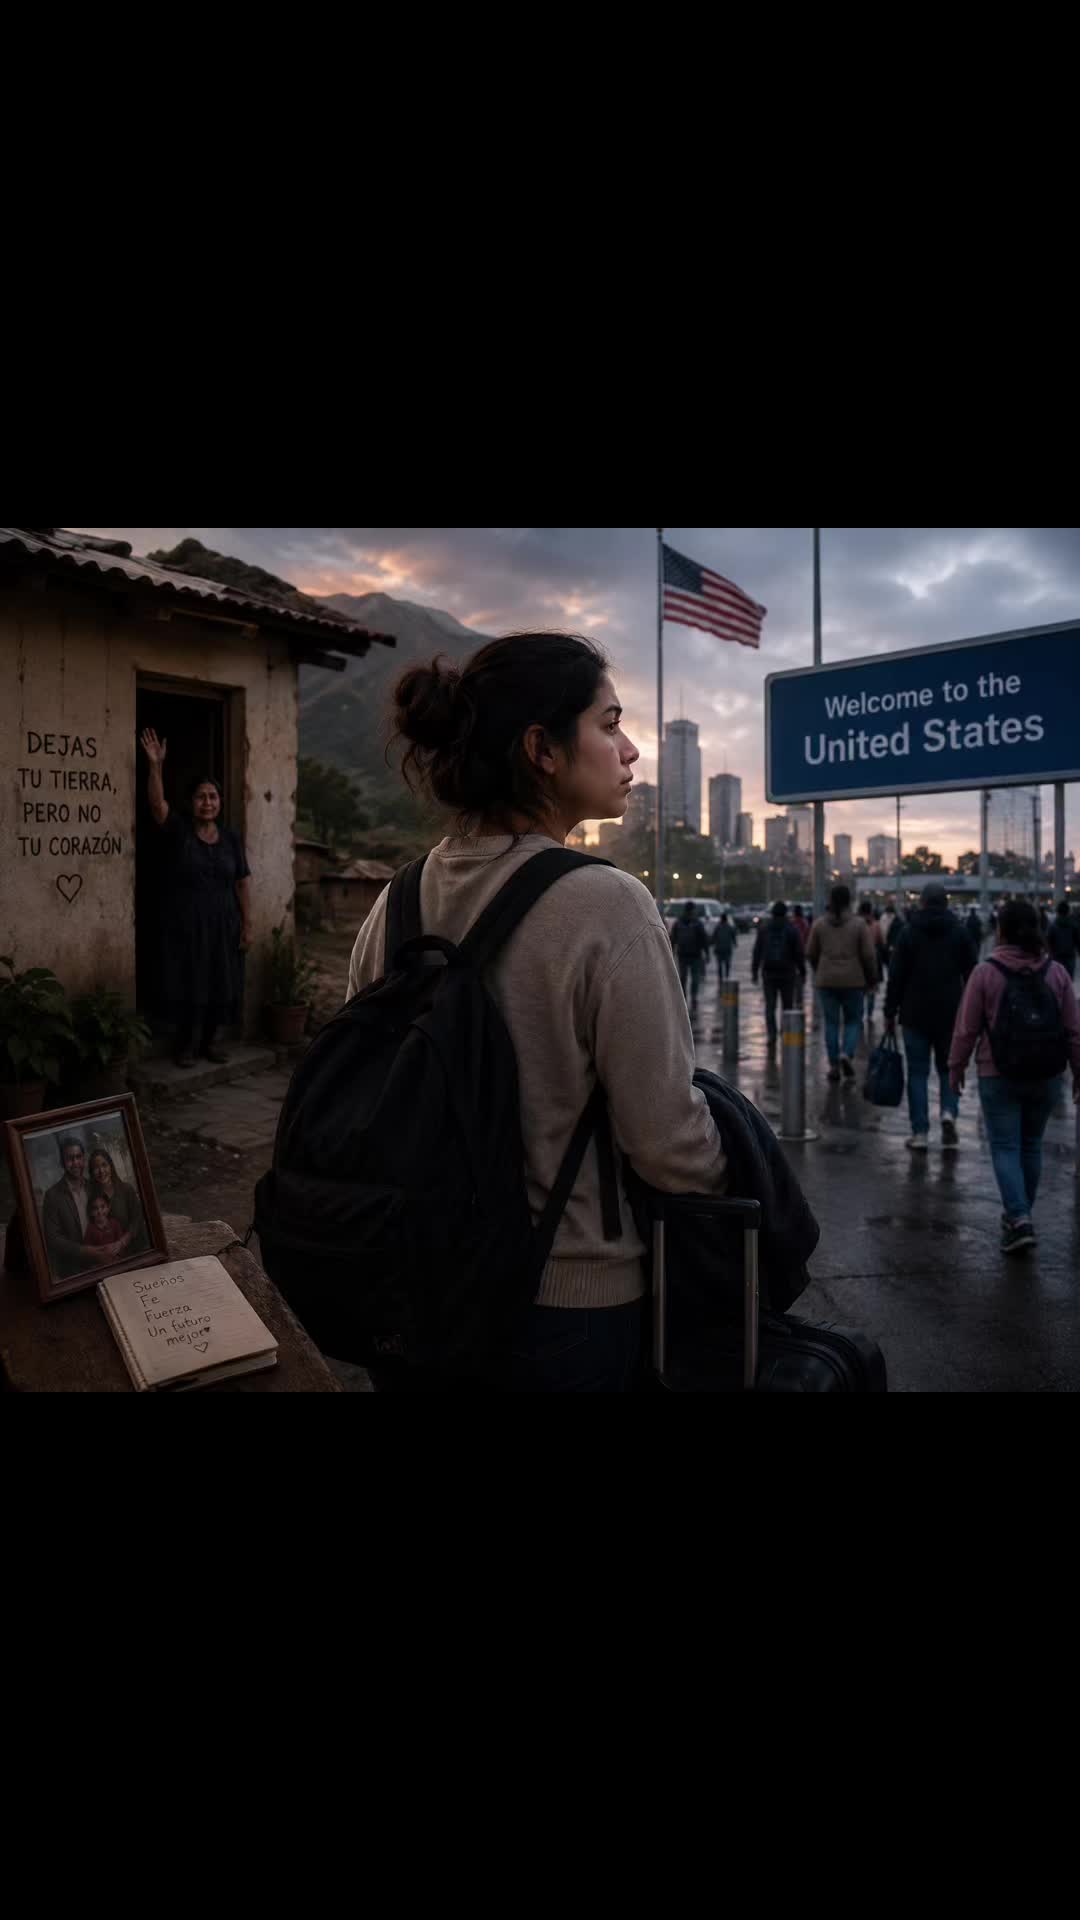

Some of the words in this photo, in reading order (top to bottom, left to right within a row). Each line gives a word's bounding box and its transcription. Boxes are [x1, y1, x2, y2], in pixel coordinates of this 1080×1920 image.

[824, 688, 934, 720] Welcome
[942, 681, 968, 702] to
[976, 672, 1022, 698] the
[27, 731, 97, 758] DEJAS
[804, 722, 911, 766] United
[922, 713, 1045, 753] States
[17, 768, 42, 789] TU
[49, 770, 117, 795] TIERRA,
[23, 802, 70, 824] PERO
[78, 804, 101, 824] NO
[17, 837, 41, 857] TU
[49, 830, 122, 856] CORAZÓN
[133, 1275, 184, 1294] Sueños
[139, 1294, 160, 1307] Fe
[144, 1305, 192, 1322] Fuerza
[147, 1327, 167, 1338] Un
[171, 1316, 211, 1331] futuro
[166, 1330, 204, 1346] mejor
